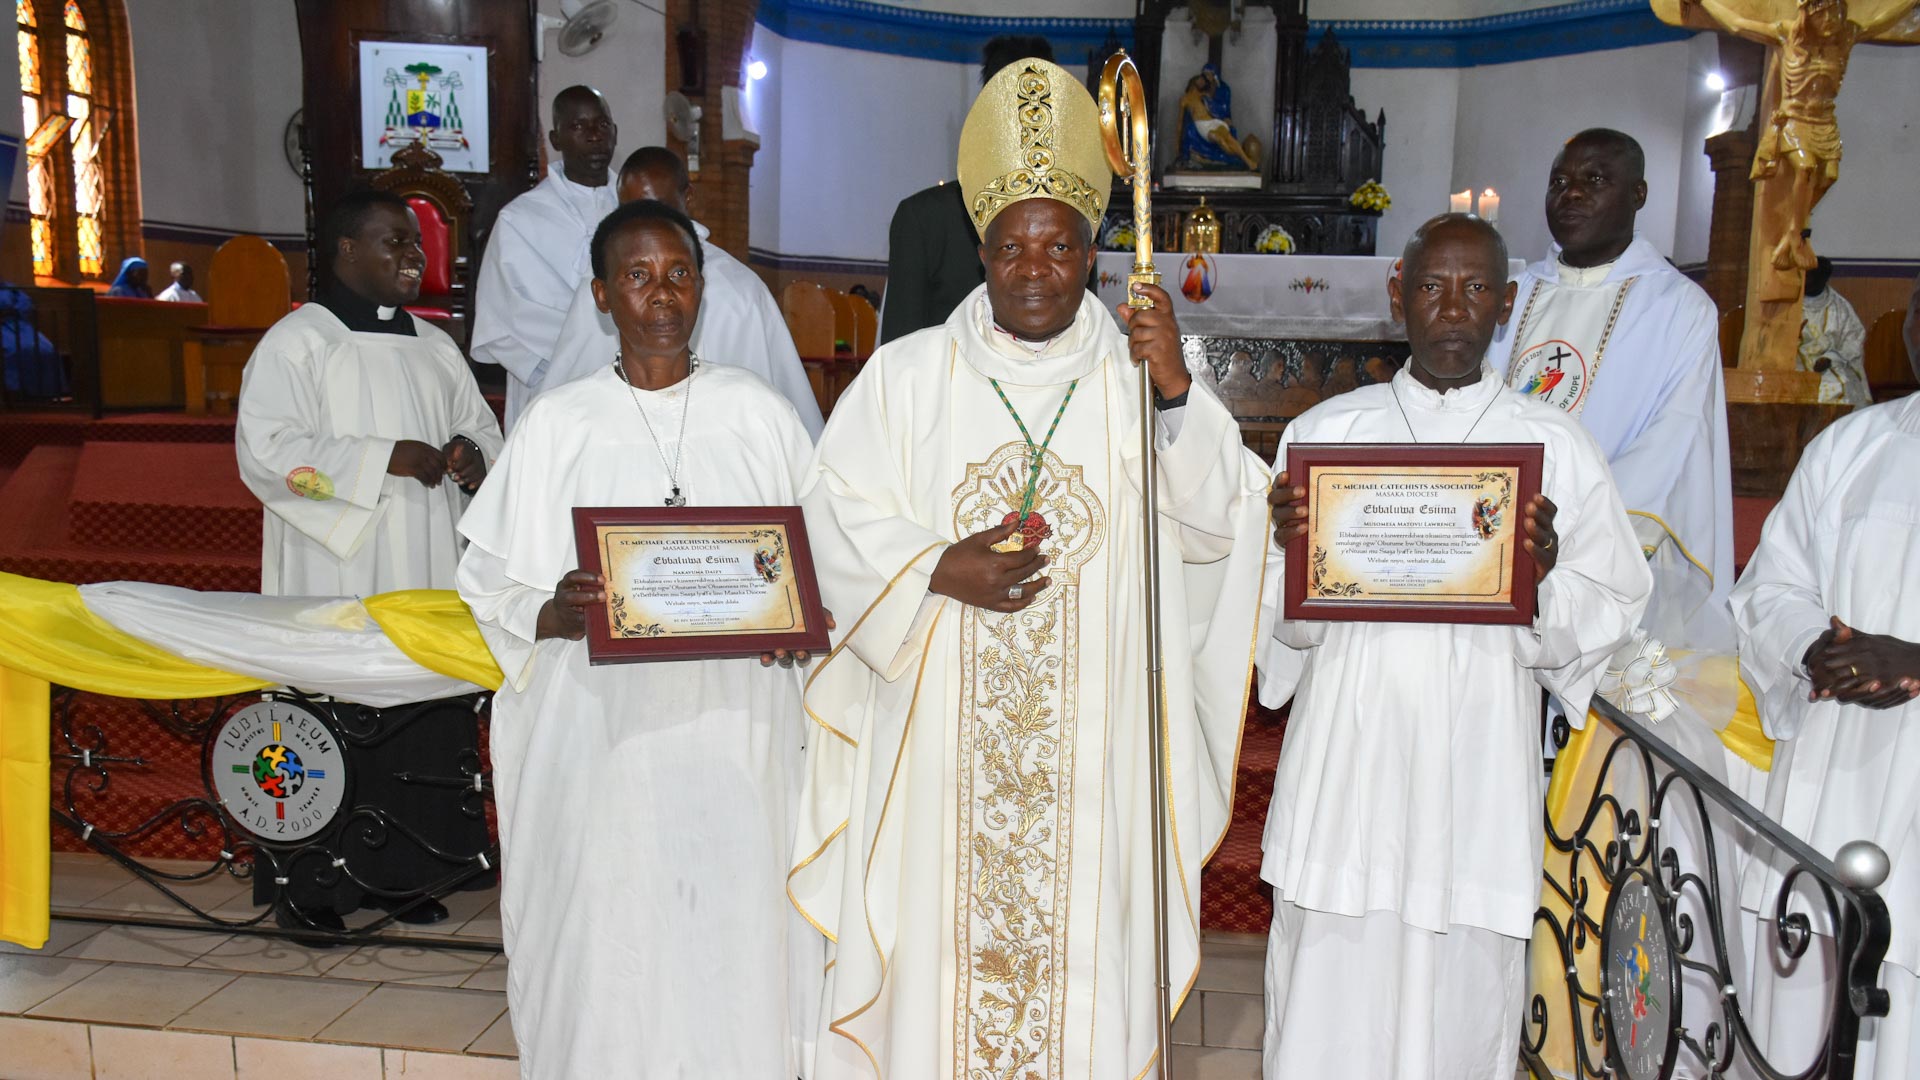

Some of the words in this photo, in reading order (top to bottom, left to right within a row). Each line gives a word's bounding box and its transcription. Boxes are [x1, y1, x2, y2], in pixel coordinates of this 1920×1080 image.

[1515, 357, 1529, 380] JUBILEE
[1559, 400, 1569, 409] OF
[1568, 374, 1580, 398] HOPE
[224, 709, 331, 755] IUBILAEUM
[299, 787, 320, 812] SEMPER
